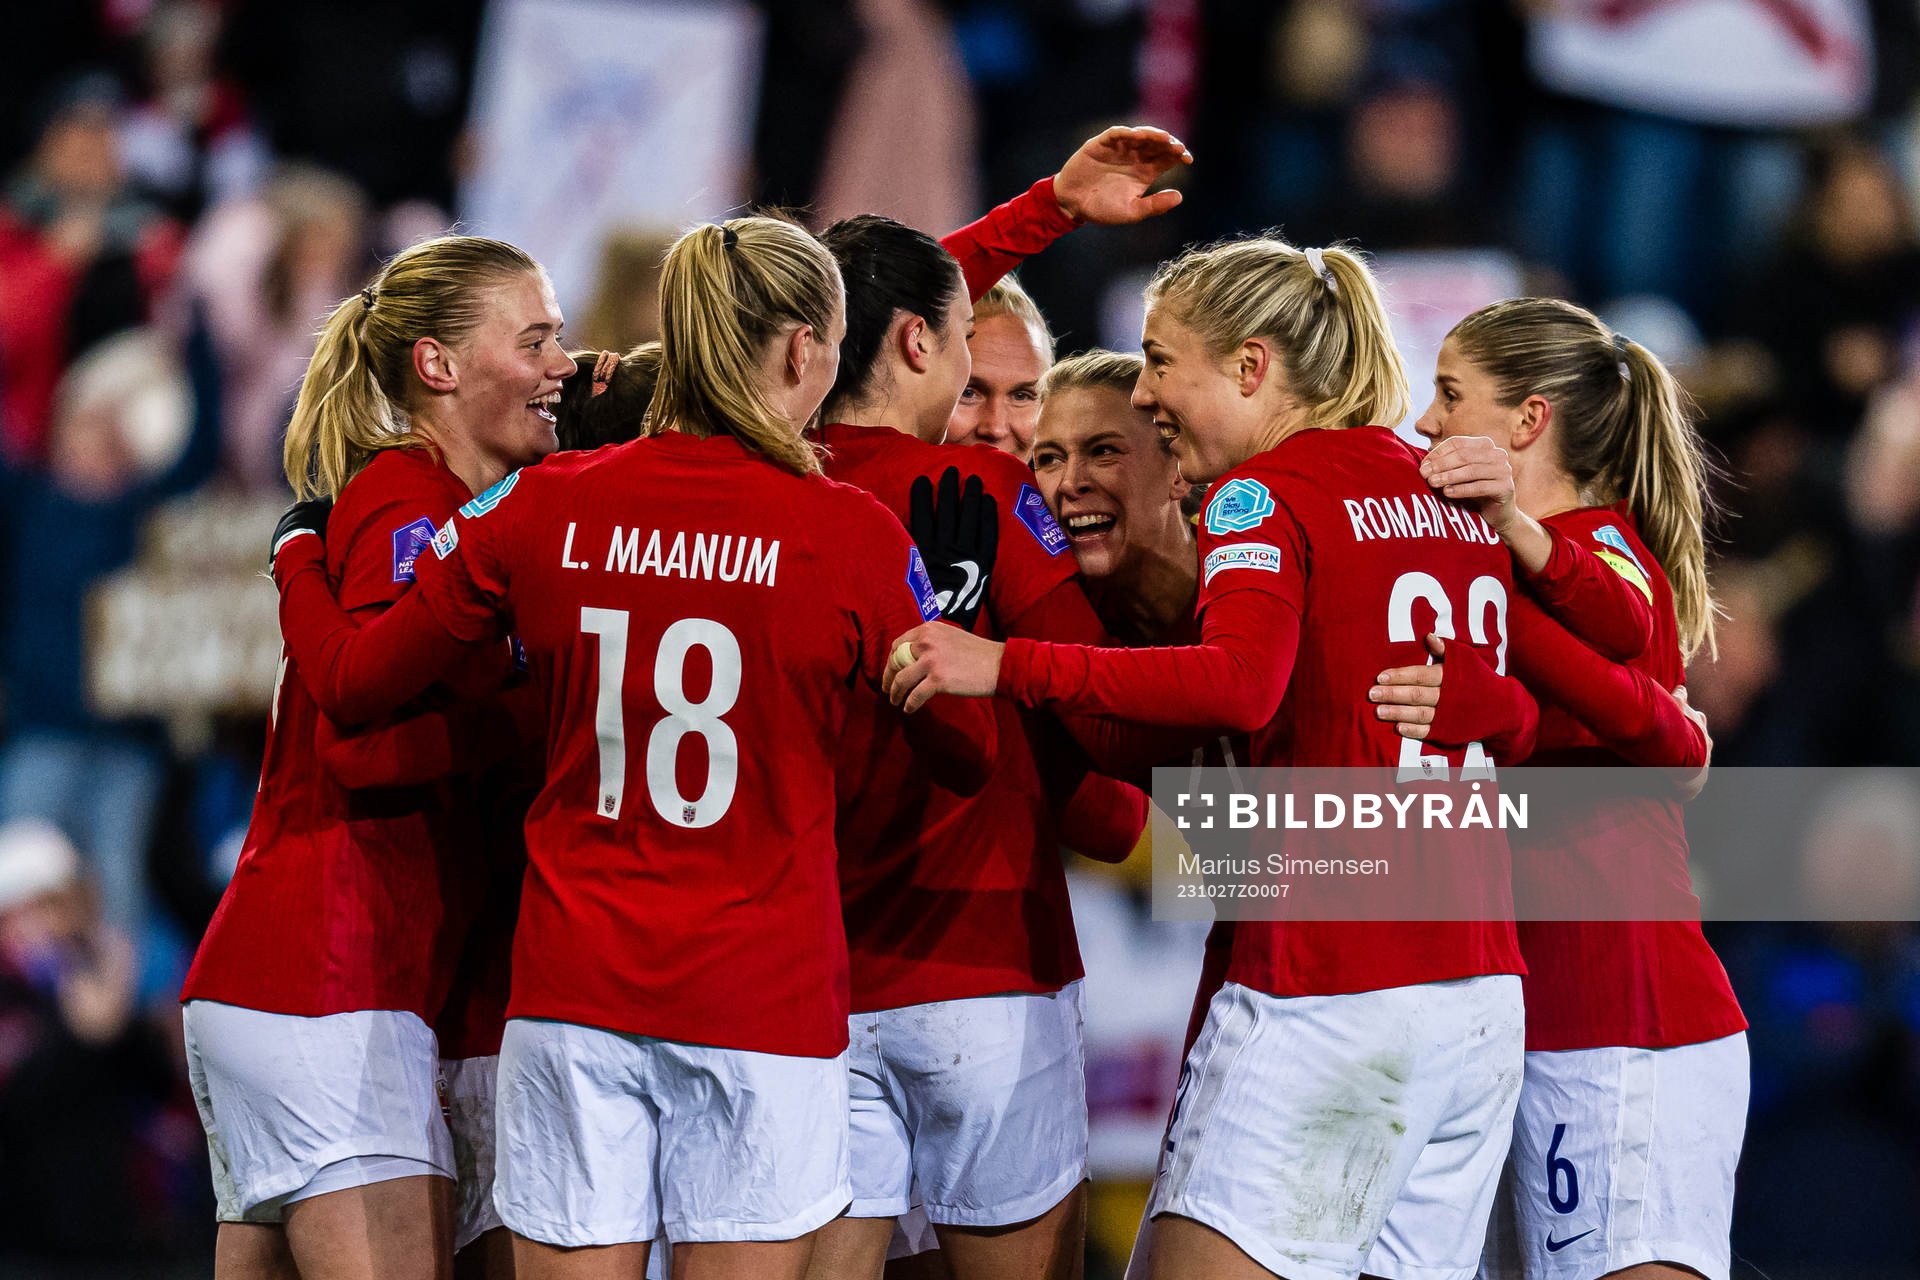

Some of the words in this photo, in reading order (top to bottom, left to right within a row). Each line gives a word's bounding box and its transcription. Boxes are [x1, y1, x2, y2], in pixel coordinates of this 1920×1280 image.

[562, 522, 590, 569] L.
[605, 525, 780, 587] MAANUM
[1343, 494, 1448, 541] ROMAN
[580, 606, 742, 828] 18
[1546, 1123, 1579, 1214] 6
